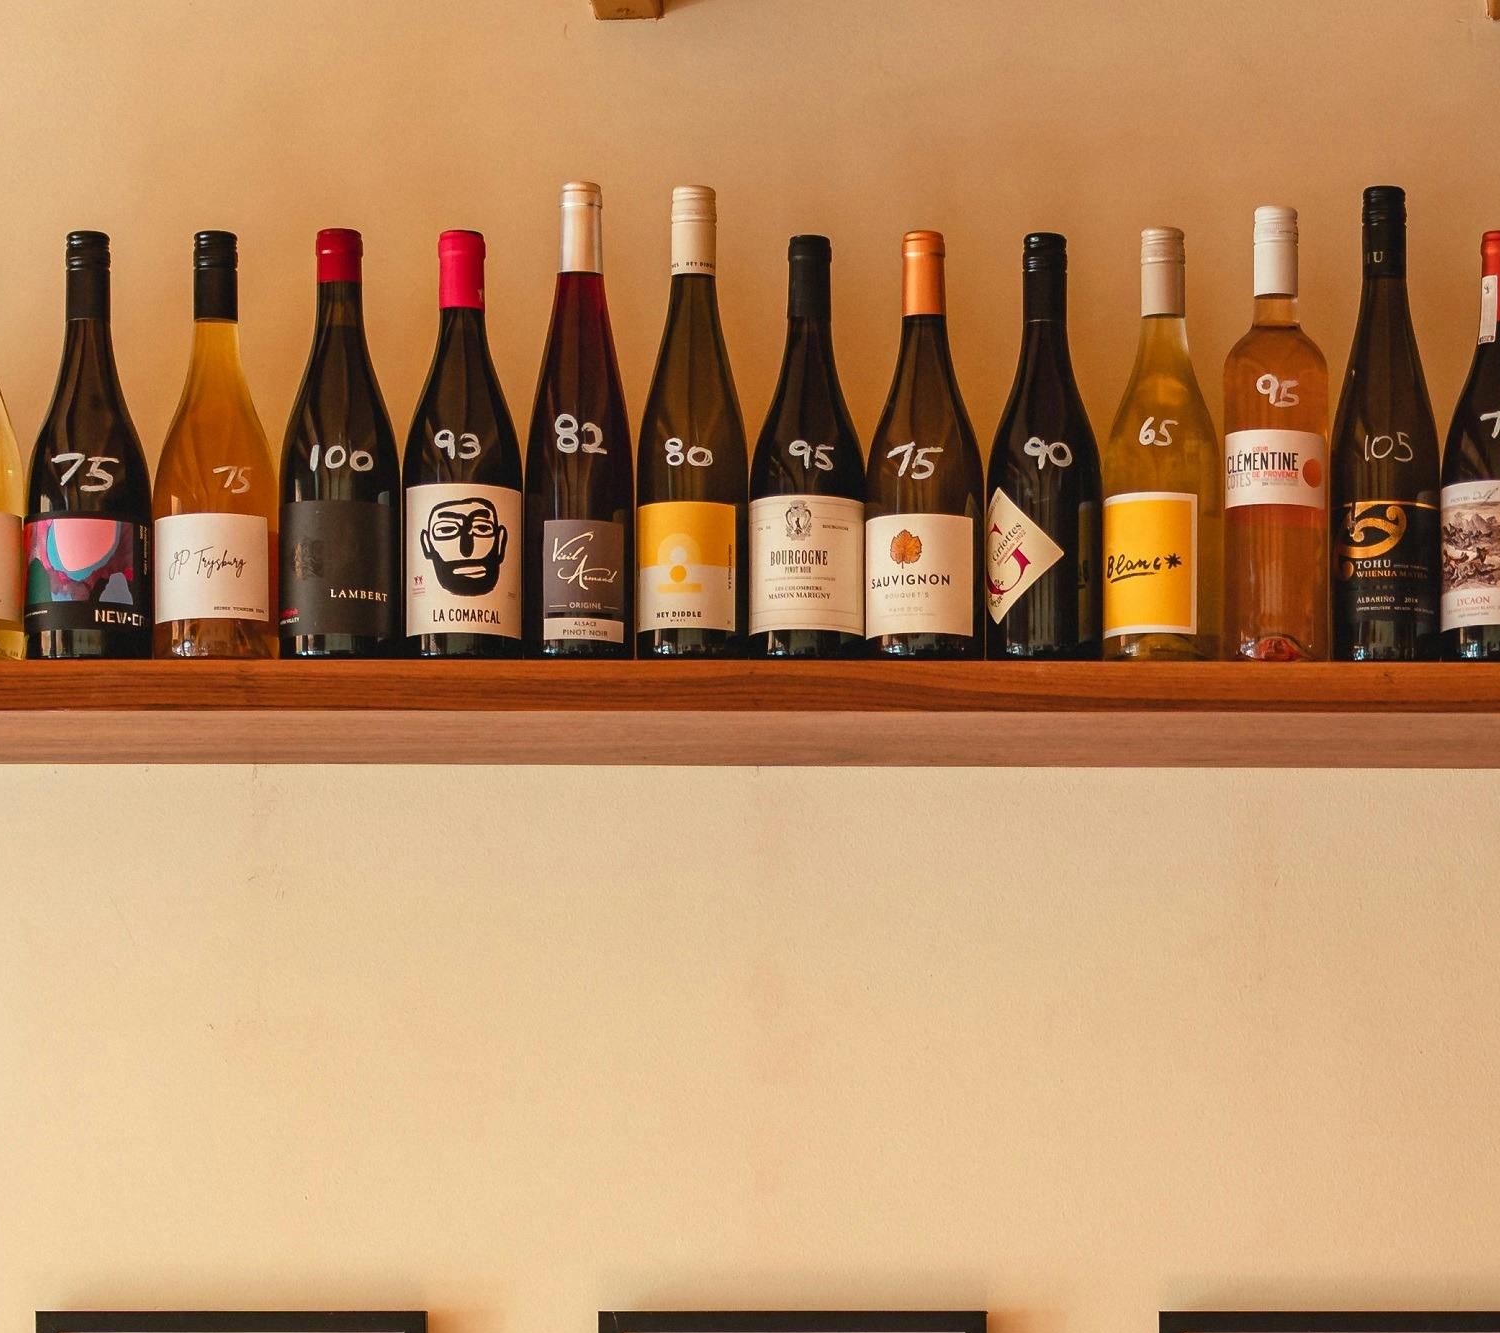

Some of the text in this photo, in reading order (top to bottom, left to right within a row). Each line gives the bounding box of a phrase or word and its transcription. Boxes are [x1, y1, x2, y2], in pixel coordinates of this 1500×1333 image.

[1256, 373, 1300, 408] 95
[433, 429, 482, 460] 93
[554, 413, 608, 455] 82
[1138, 416, 1180, 447] 65
[309, 444, 374, 472] 100
[664, 437, 714, 467] 80
[788, 439, 835, 471] 95
[1023, 436, 1073, 470] 90
[1363, 431, 1414, 463] 105
[51, 452, 120, 492] 75
[886, 441, 944, 480] 75
[1227, 449, 1299, 475] CLÉMENTINE
[212, 465, 253, 494] 75
[1263, 470, 1299, 480] PROVENCE
[991, 520, 1023, 563] Griottes
[770, 550, 828, 567] BOURGOGNE
[784, 566, 812, 574] PINOT NOIR
[1355, 559, 1391, 570] TOHU
[871, 574, 951, 590] SAUVIGNON
[1355, 569, 1398, 579] WHENUA
[330, 588, 388, 602] LAMBERT
[569, 601, 602, 610] ORIGINE
[768, 591, 832, 601] MAISON MARIGNY
[432, 608, 501, 625] LA COMARCAL
[573, 620, 597, 628] ALSACE
[656, 610, 702, 619] HEY DIDDLE
[562, 628, 609, 638] PINOT NOIR
